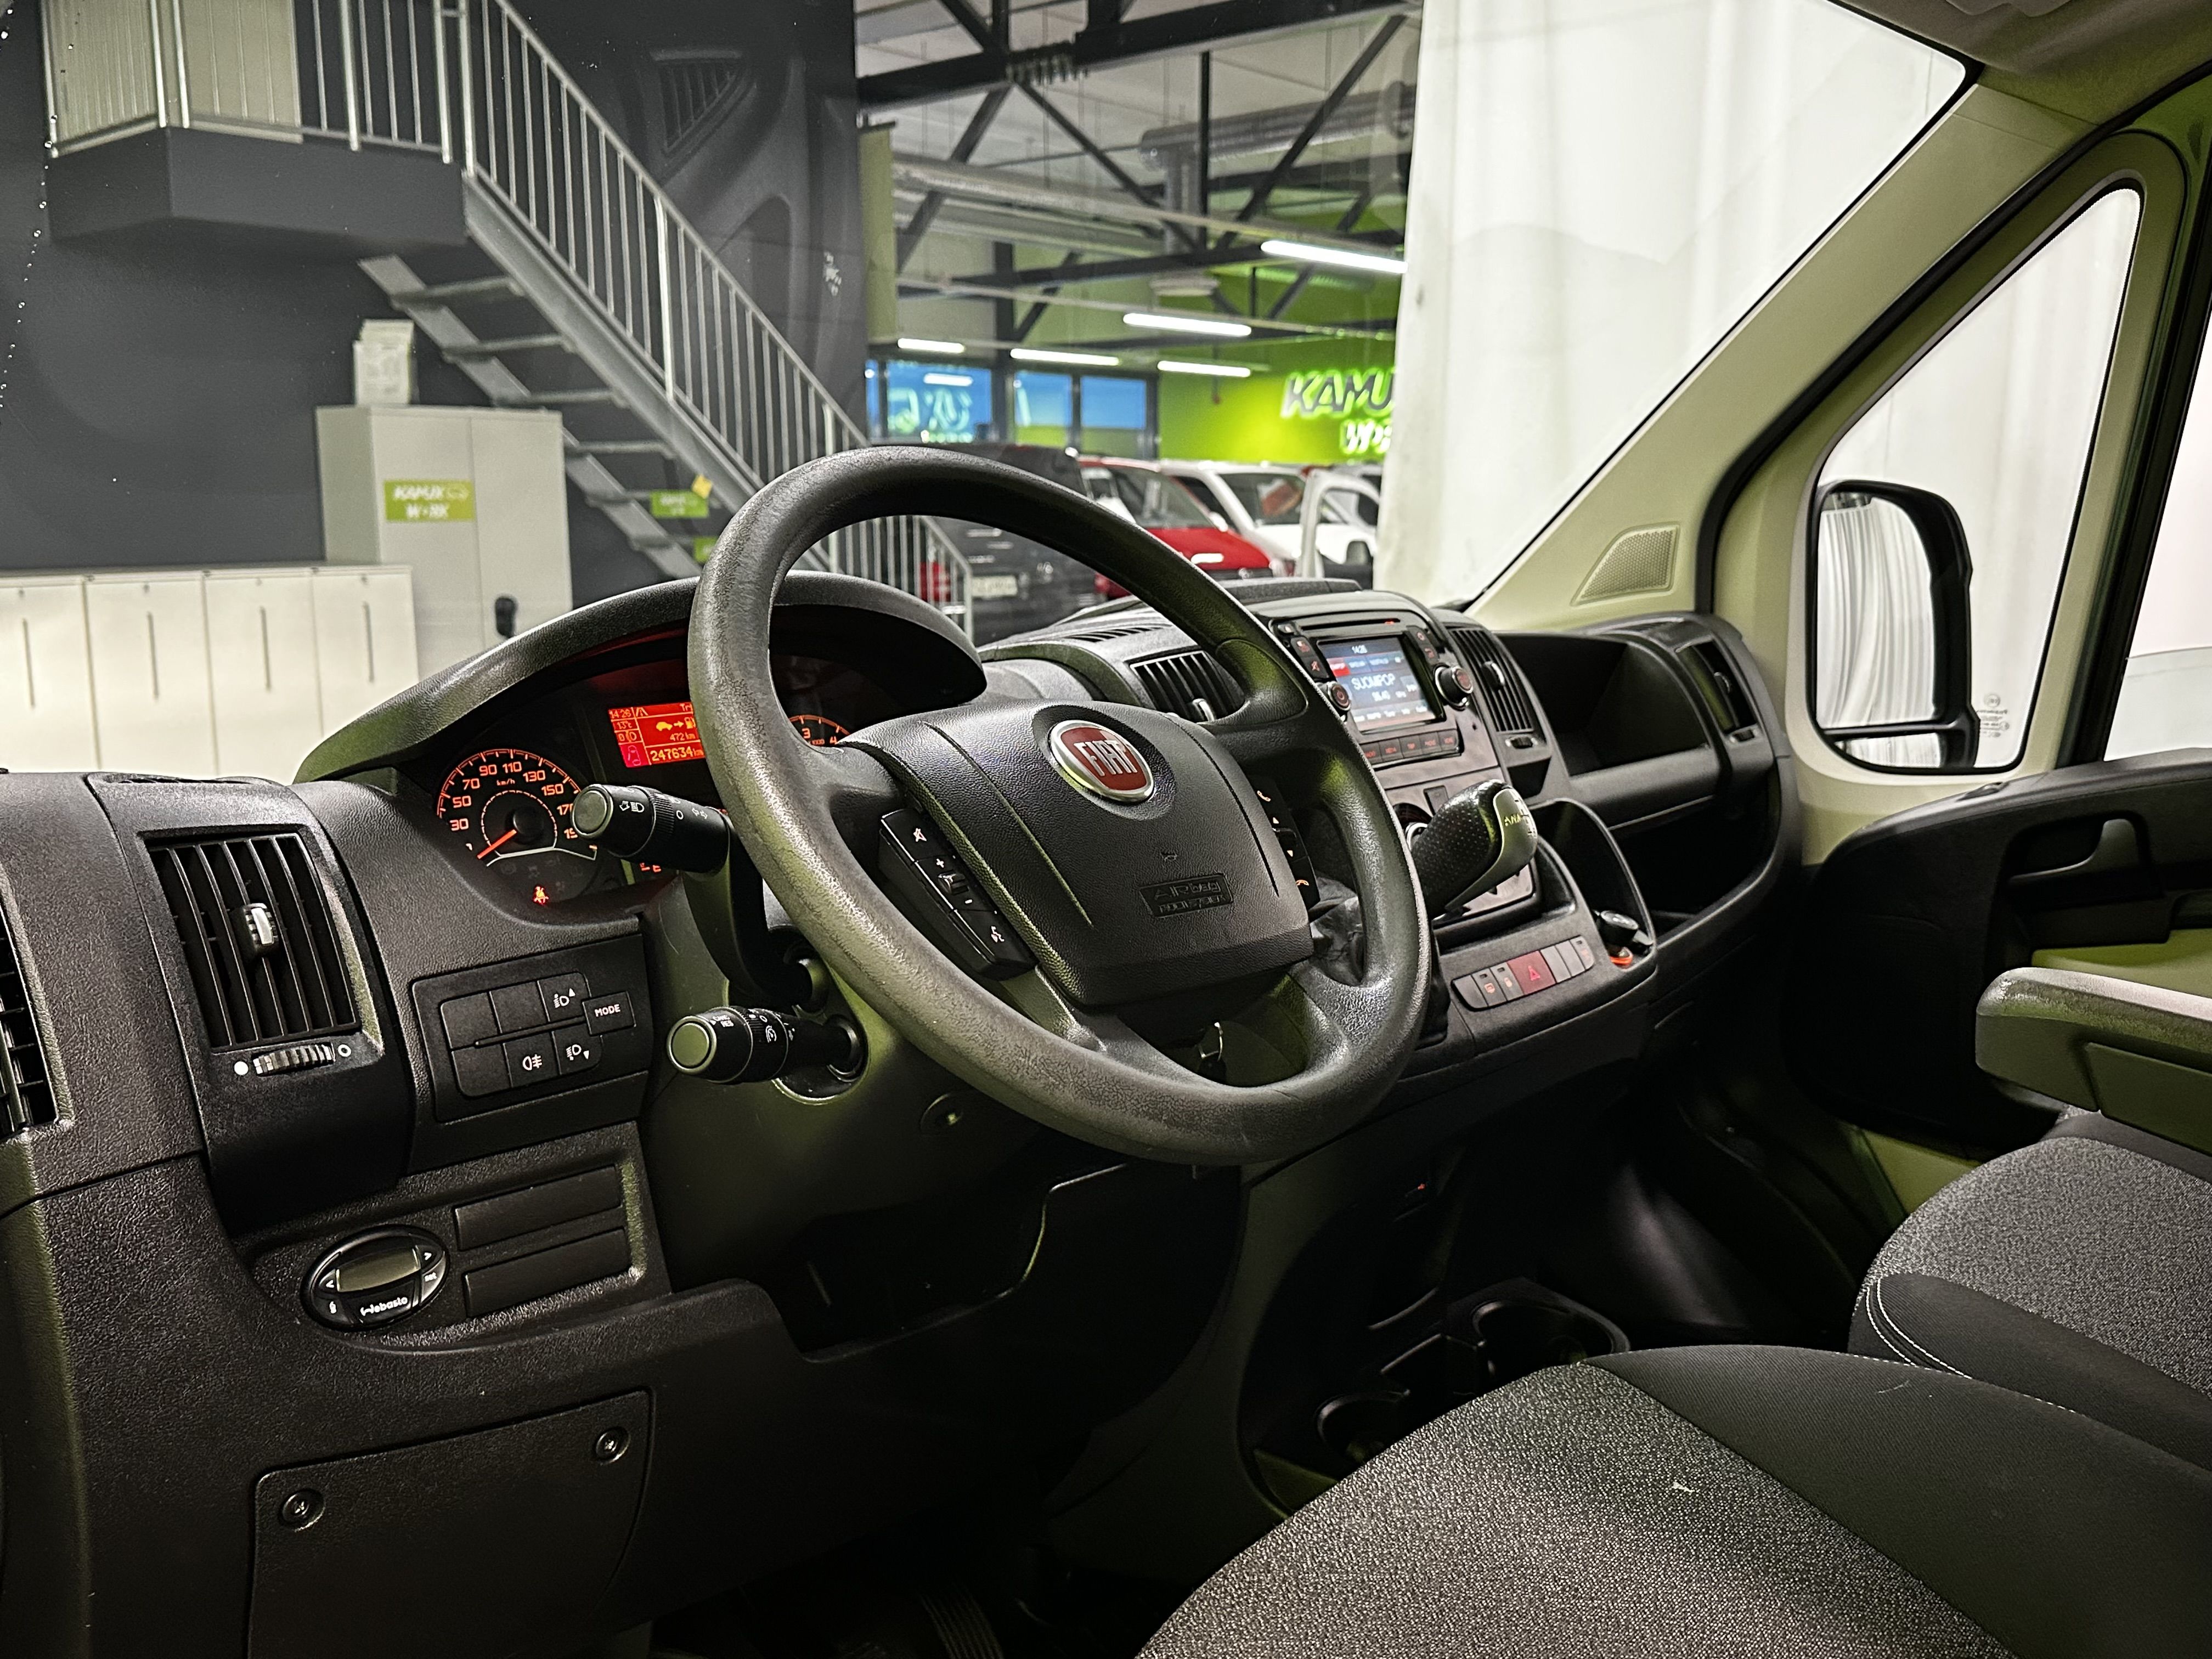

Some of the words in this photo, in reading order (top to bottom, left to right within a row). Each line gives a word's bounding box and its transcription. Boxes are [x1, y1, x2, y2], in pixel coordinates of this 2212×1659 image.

[1281, 371, 1395, 418] KAMU
[650, 746, 693, 761] 247634
[1074, 741, 1138, 776] FIAT
[479, 764, 498, 776] 90
[502, 761, 522, 774] 110
[496, 778, 515, 786] km/h
[522, 770, 546, 783] 130
[462, 778, 481, 791] 70
[541, 783, 565, 797] 150
[452, 795, 472, 808] 50
[556, 803, 574, 816] 17
[449, 818, 469, 831] 30
[594, 1003, 621, 1017] MODE
[424, 1272, 437, 1282] set
[360, 1296, 408, 1316] Webasto
